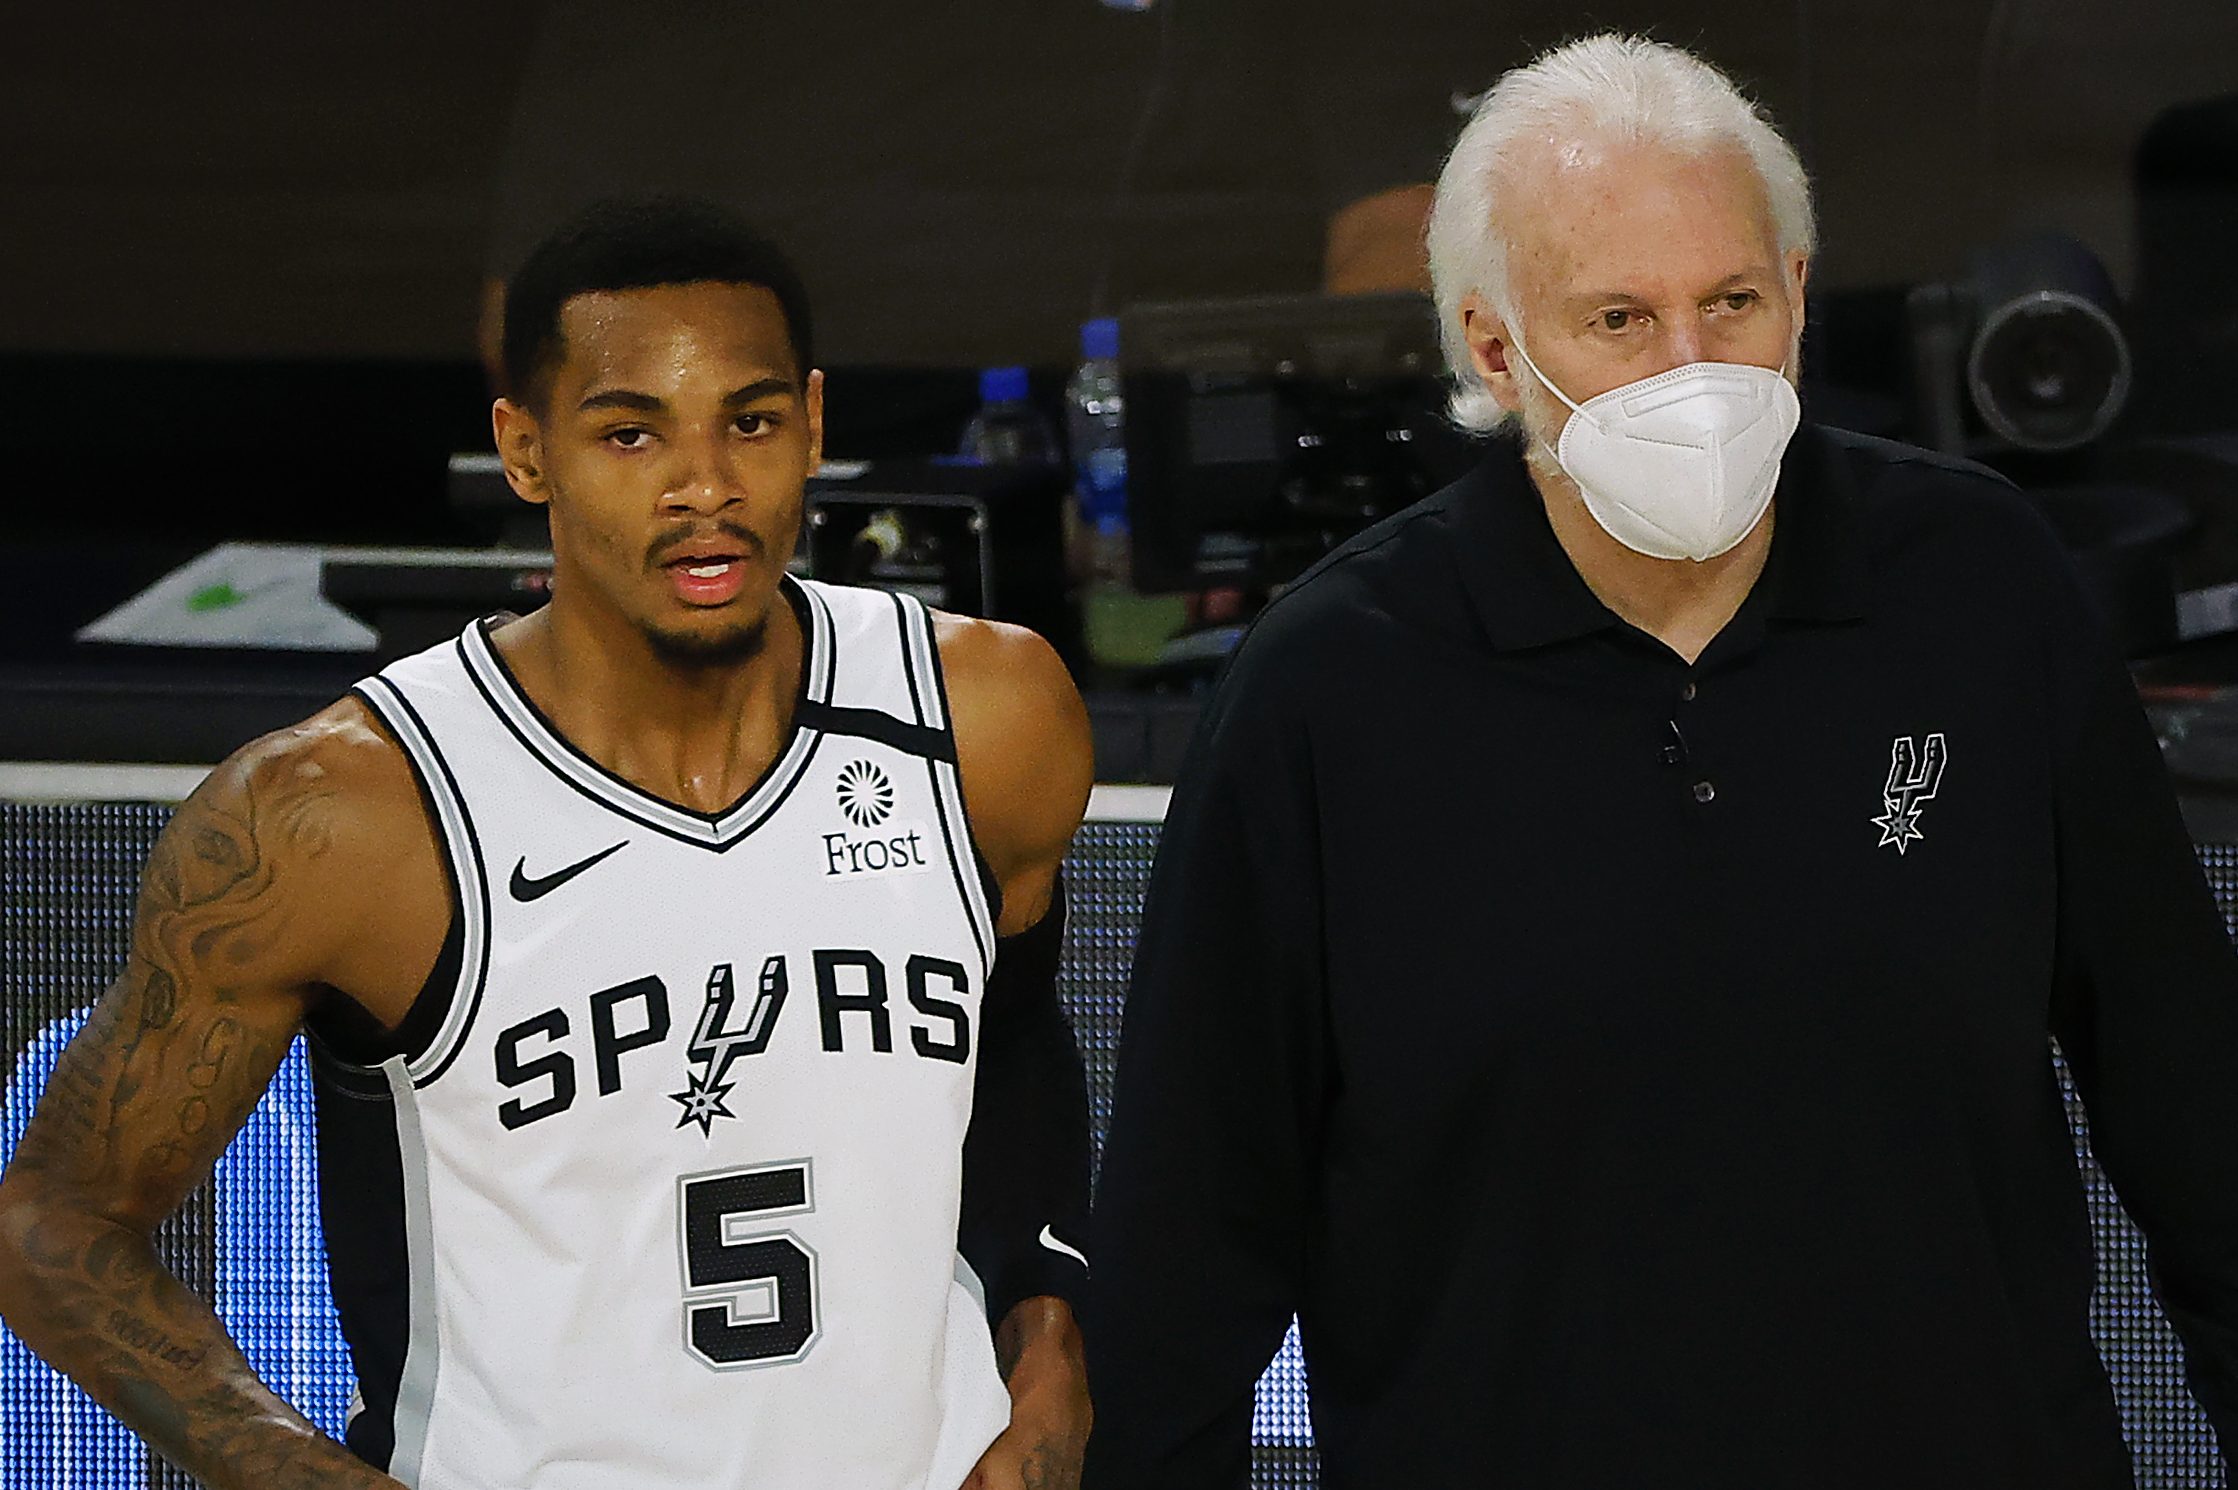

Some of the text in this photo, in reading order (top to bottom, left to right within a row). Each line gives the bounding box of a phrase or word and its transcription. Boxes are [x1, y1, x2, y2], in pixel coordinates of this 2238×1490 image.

[823, 829, 926, 876] Frost
[495, 949, 970, 1138] SPURS
[677, 1158, 823, 1372] 5
